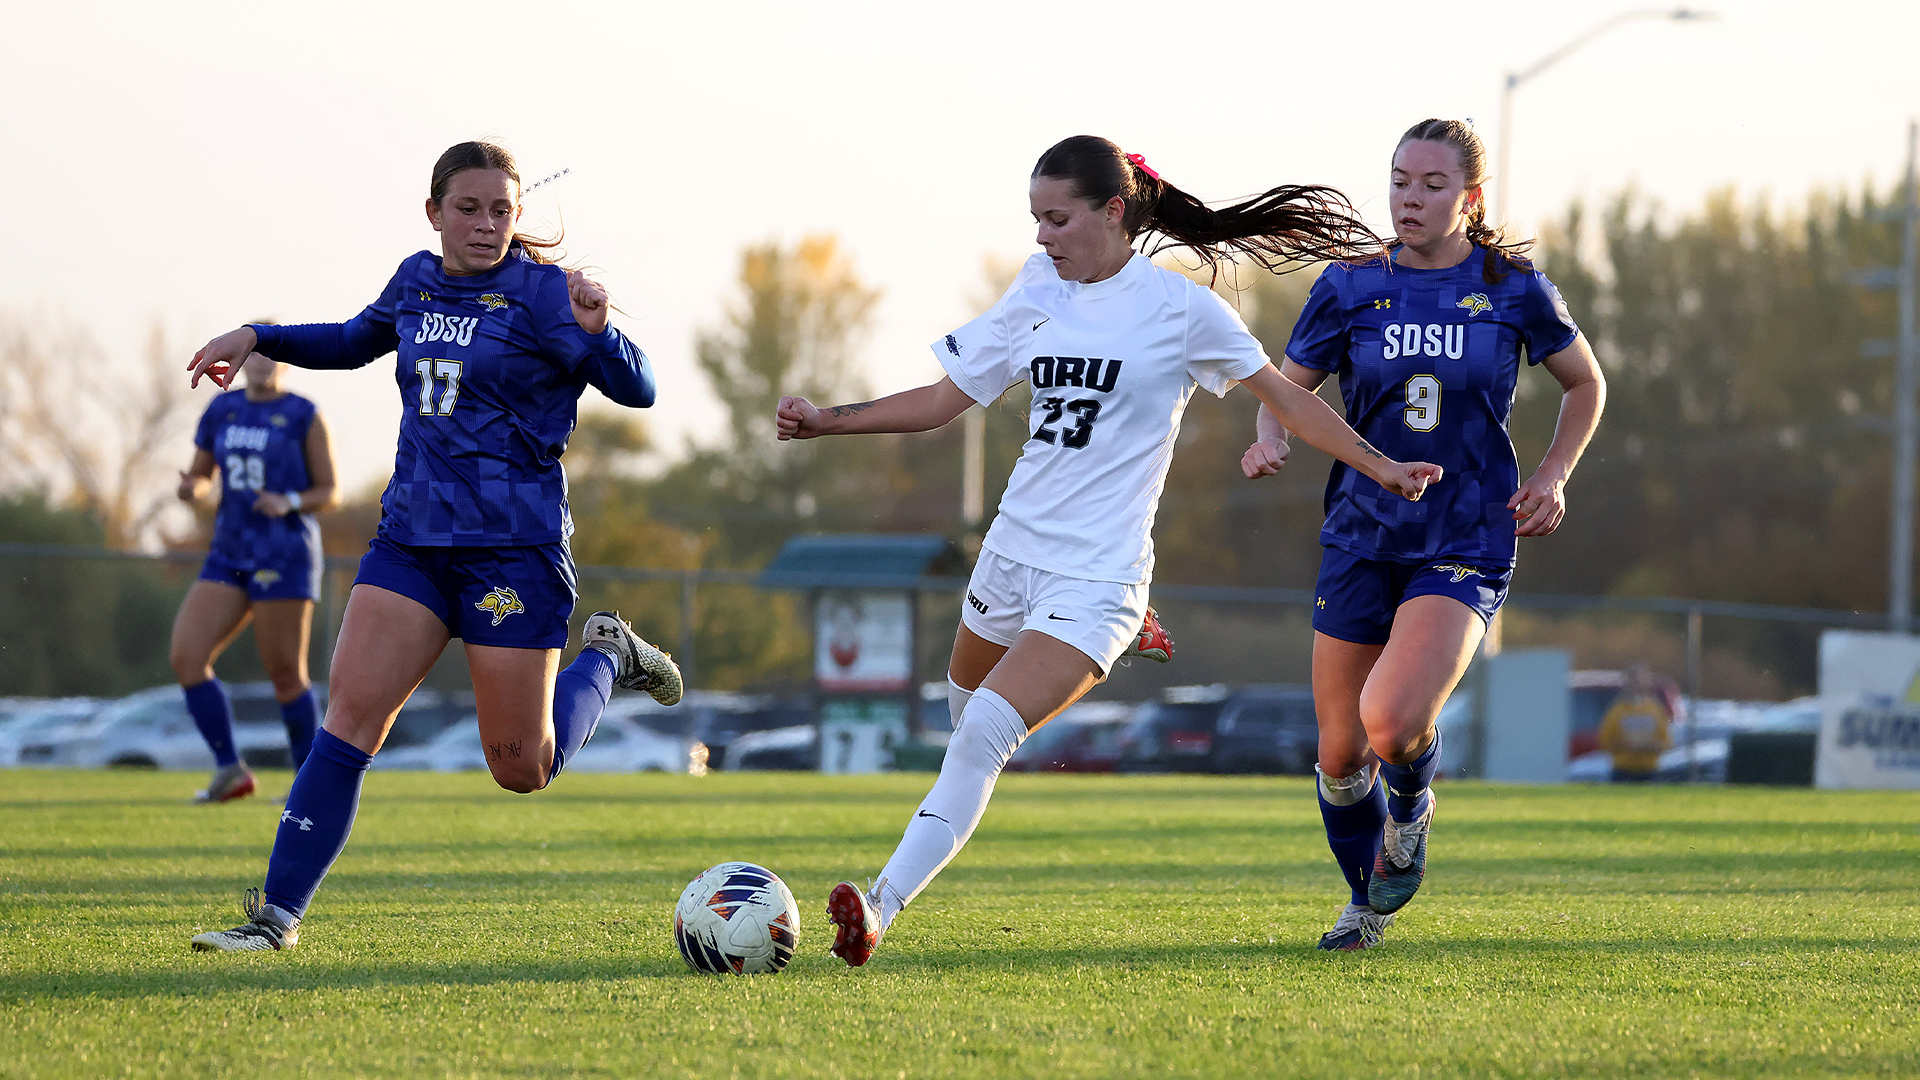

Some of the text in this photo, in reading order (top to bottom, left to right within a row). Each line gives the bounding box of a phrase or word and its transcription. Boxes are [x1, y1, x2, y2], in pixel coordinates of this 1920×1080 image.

[415, 312, 479, 346] SDSU
[1383, 323, 1464, 360] SDSU
[416, 358, 463, 416] 17
[1030, 356, 1123, 393] ORU
[1404, 374, 1442, 432] 9
[1031, 397, 1103, 450] 23
[967, 588, 989, 615] ORU
